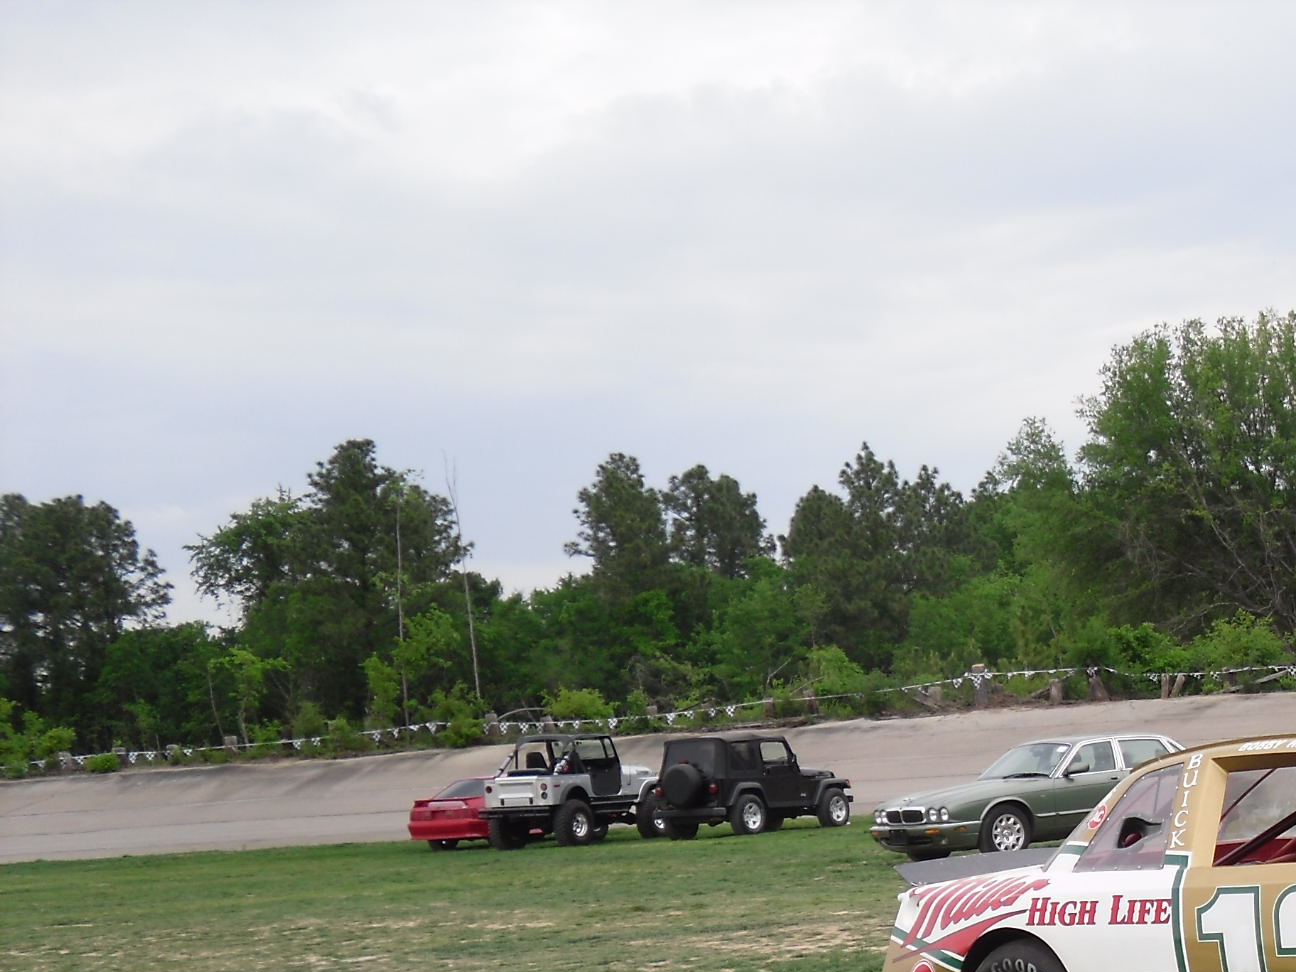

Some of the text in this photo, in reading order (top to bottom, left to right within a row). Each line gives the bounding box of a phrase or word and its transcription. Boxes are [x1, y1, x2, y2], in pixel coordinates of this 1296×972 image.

[1238, 740, 1287, 752] BOBBY
[1169, 753, 1205, 848] BUICK
[901, 875, 1051, 948] Miller
[1026, 895, 1172, 927] HIGH LIFE
